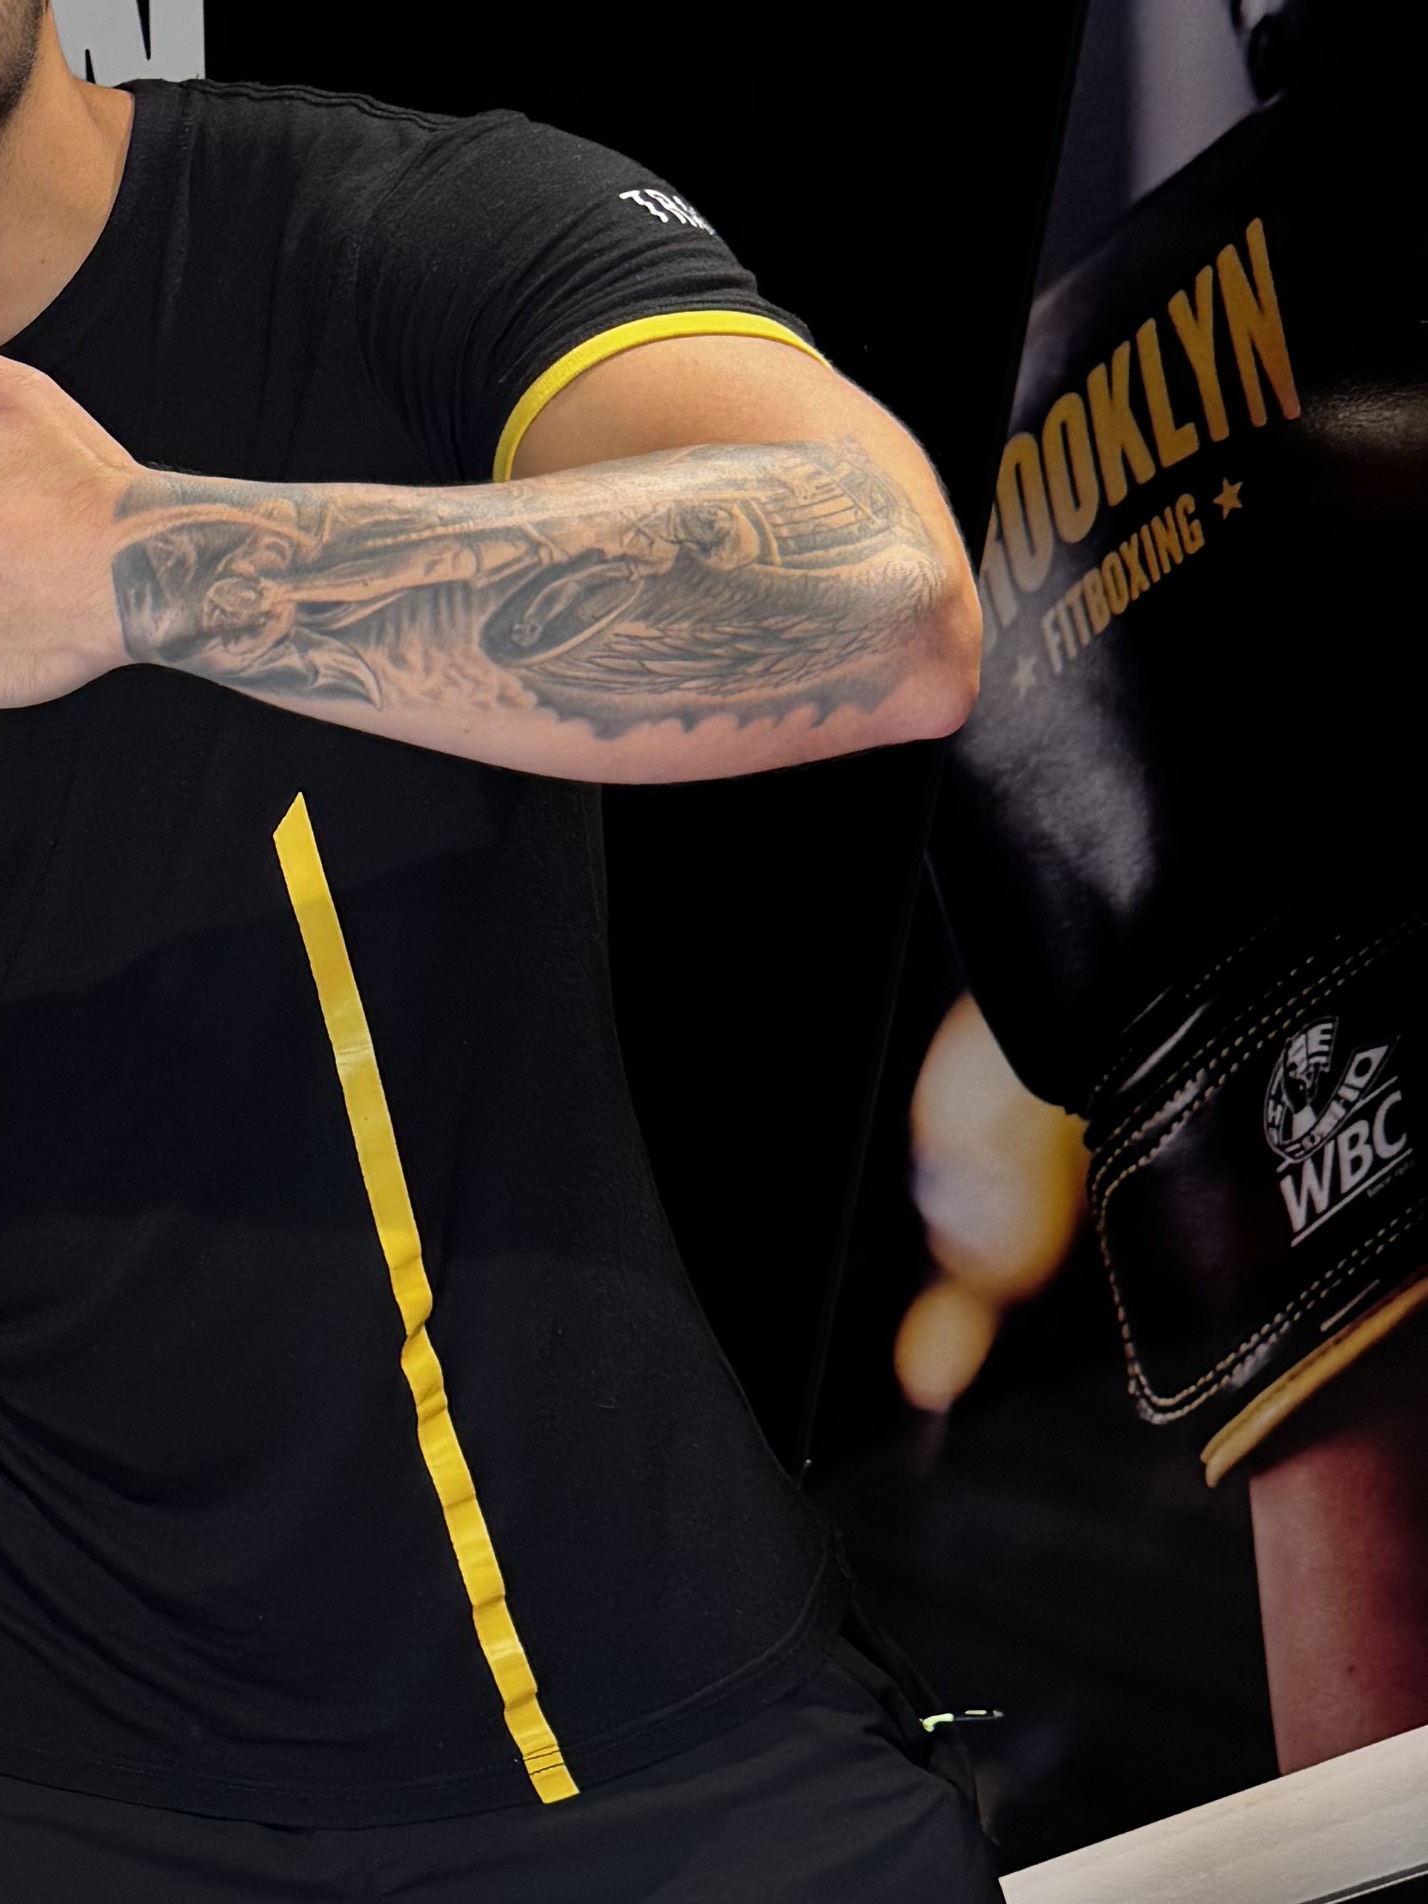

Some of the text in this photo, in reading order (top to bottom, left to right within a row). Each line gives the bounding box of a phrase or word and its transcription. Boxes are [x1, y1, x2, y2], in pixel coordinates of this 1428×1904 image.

[980, 217, 1301, 654] OOKLYN
[1041, 493, 1205, 676] FITBOXING
[1280, 1090, 1407, 1233] WBC
